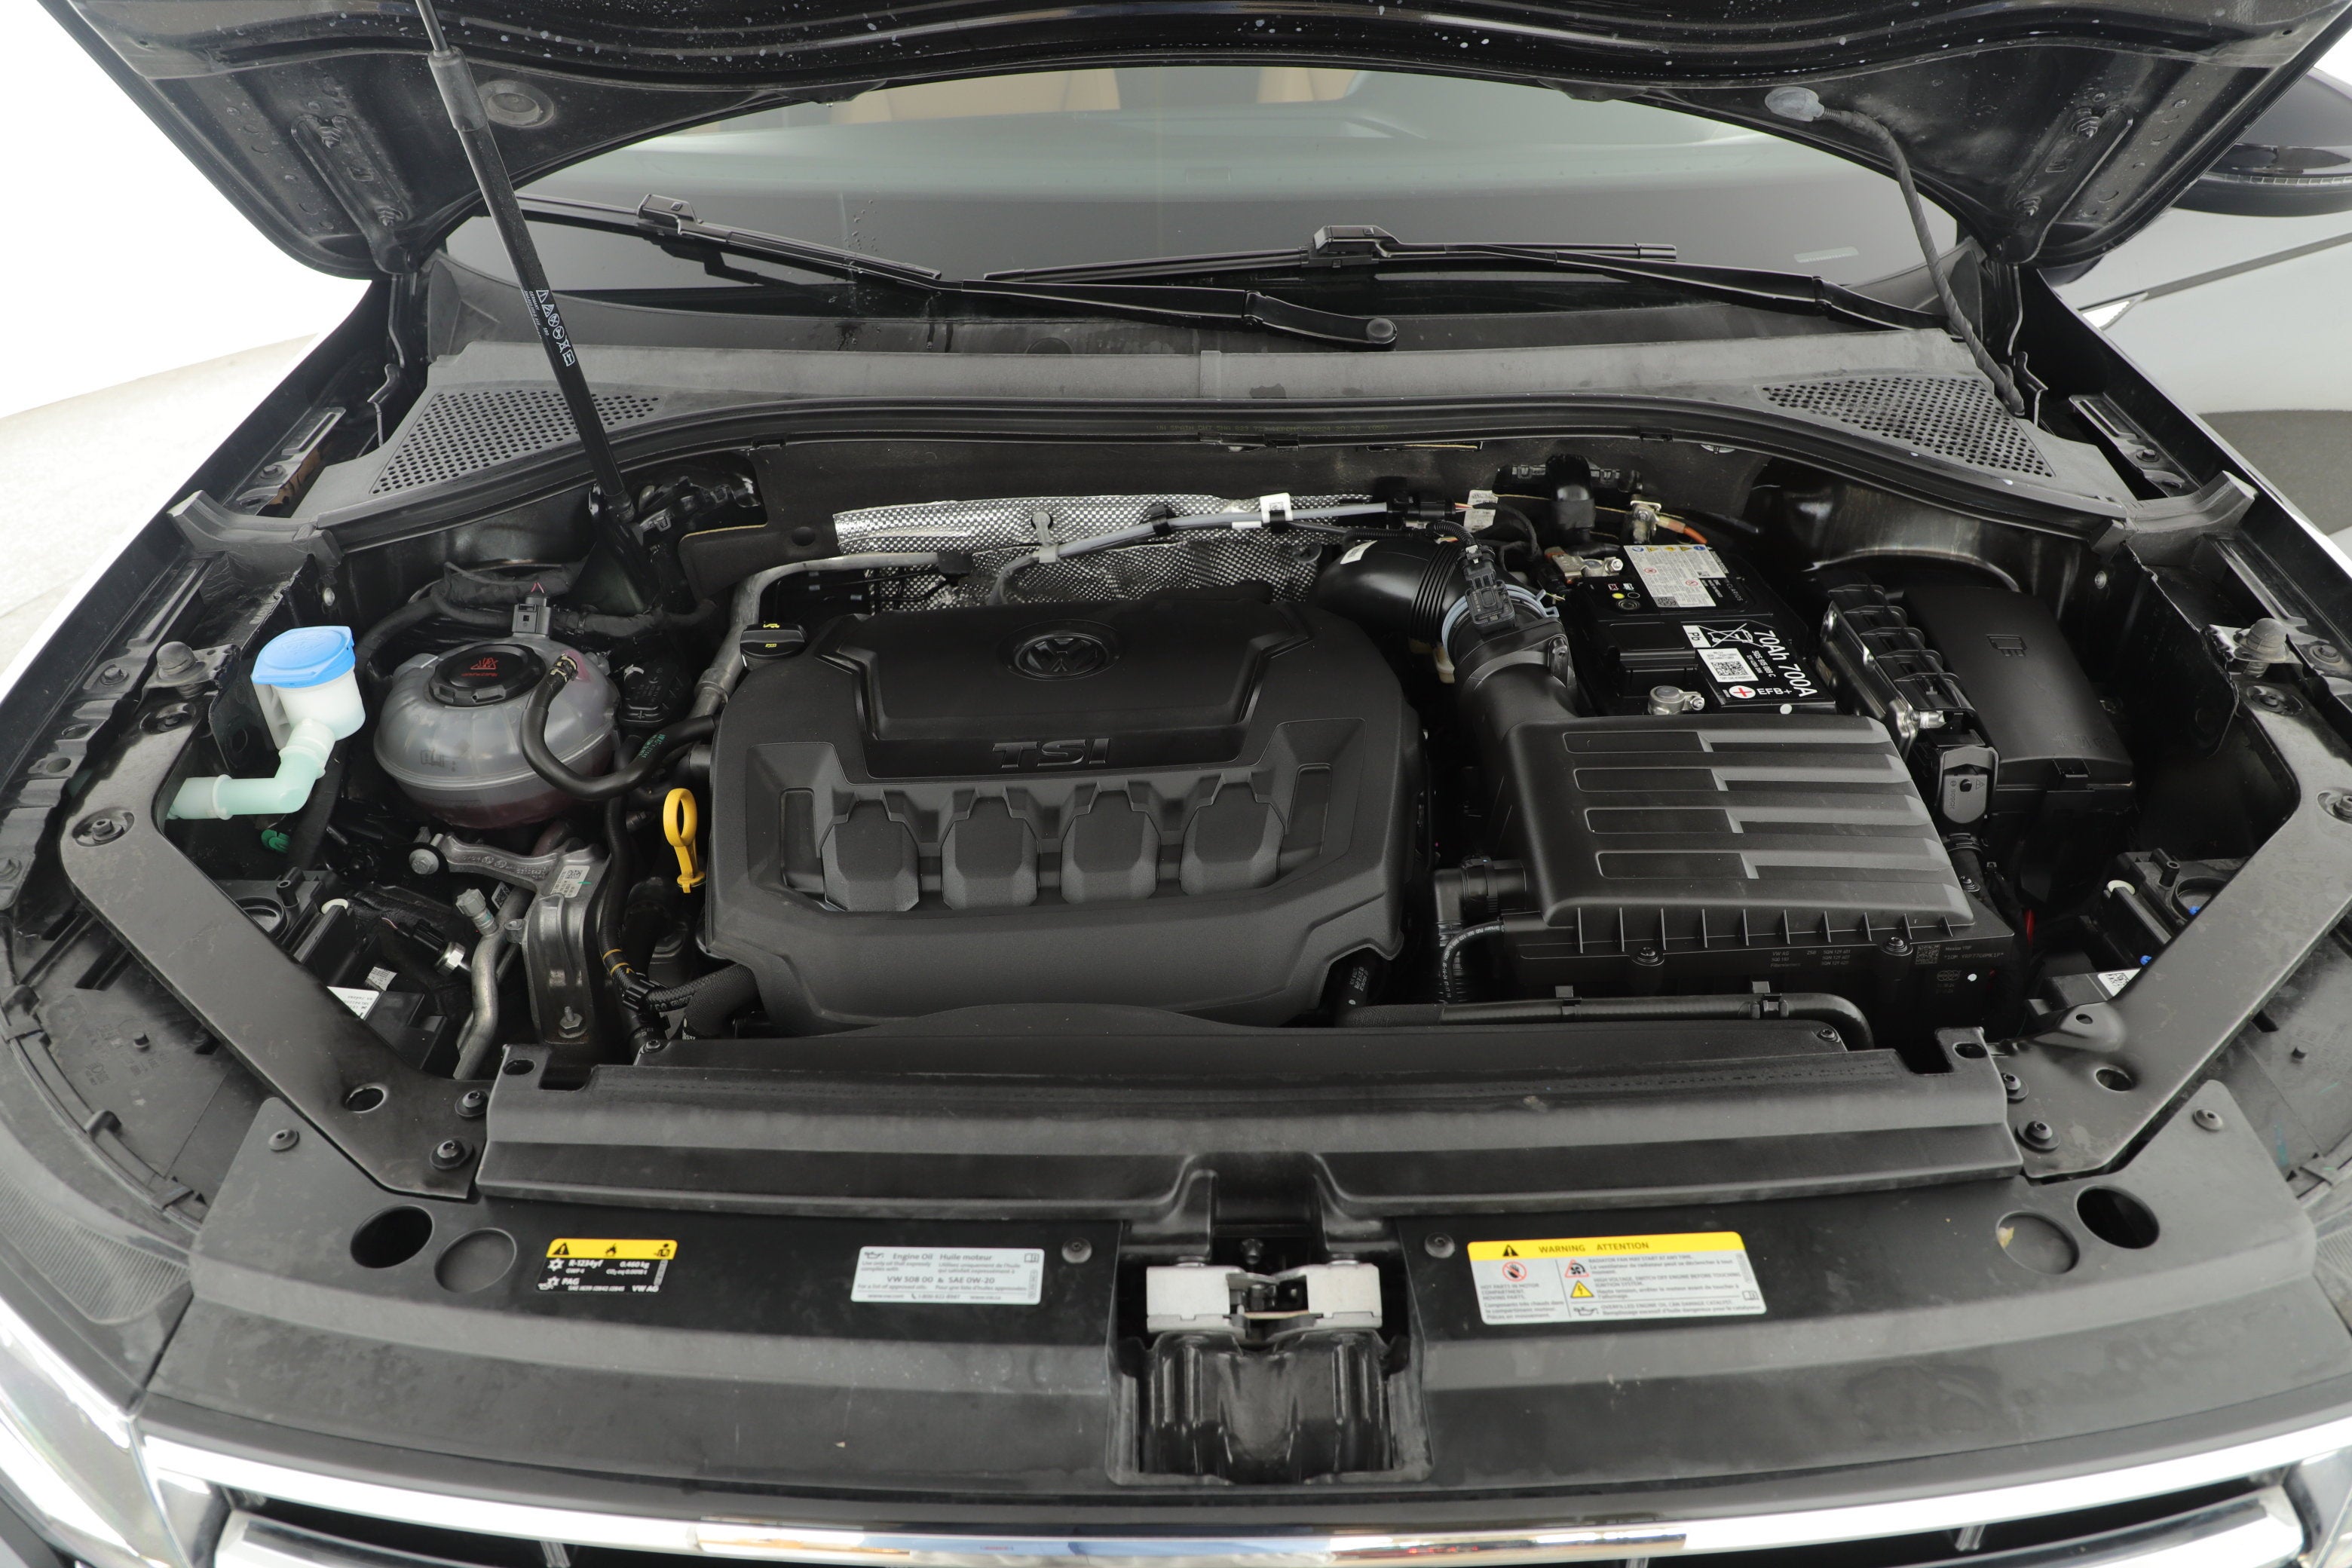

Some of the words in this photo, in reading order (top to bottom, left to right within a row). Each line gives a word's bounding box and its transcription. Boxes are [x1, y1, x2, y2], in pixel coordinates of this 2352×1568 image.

[529, 290, 540, 311] GERMANY
[1688, 632, 1701, 641] Pb
[1753, 630, 1790, 660] 70Ah
[1778, 663, 1818, 697] 700A
[1756, 687, 1793, 695] EFB+
[992, 738, 1110, 769] TSI
[1538, 1244, 1586, 1254] WARNING
[1597, 1242, 1649, 1251] ATTENTION
[893, 1252, 920, 1261] Engine
[561, 1277, 580, 1285] PAG
